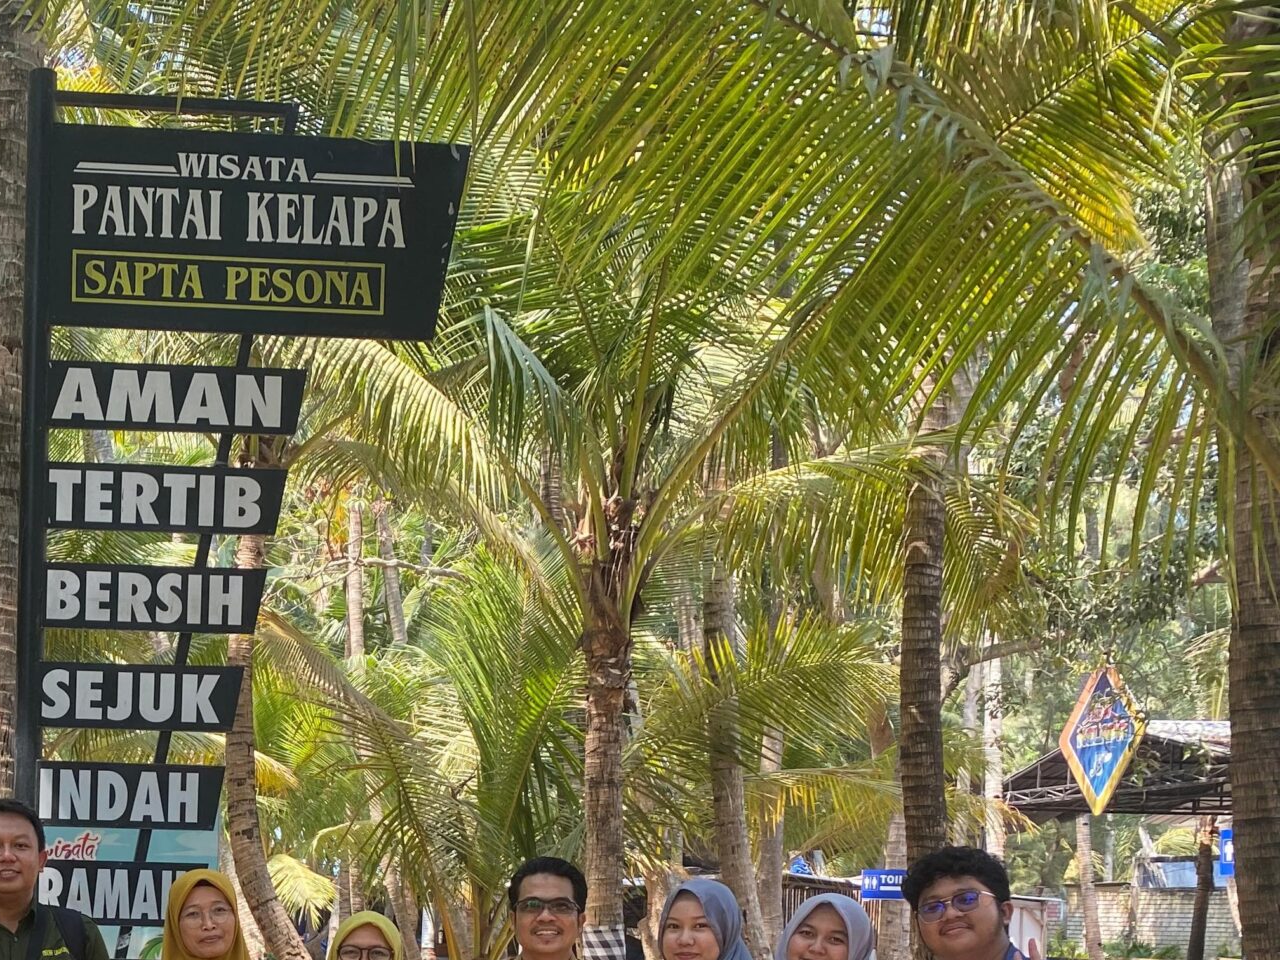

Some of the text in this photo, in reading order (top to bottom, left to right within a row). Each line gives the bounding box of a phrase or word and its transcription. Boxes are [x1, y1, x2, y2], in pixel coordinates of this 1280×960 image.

[177, 153, 311, 183] WISATA
[72, 184, 406, 248] PANTAI KELAPA
[83, 260, 373, 306] SAPTA PESONA
[51, 367, 282, 428] AMAN
[49, 469, 262, 528] TERTIB
[46, 569, 243, 626] BERSIH
[41, 669, 220, 724] SEJUK
[39, 768, 199, 823] INDAH
